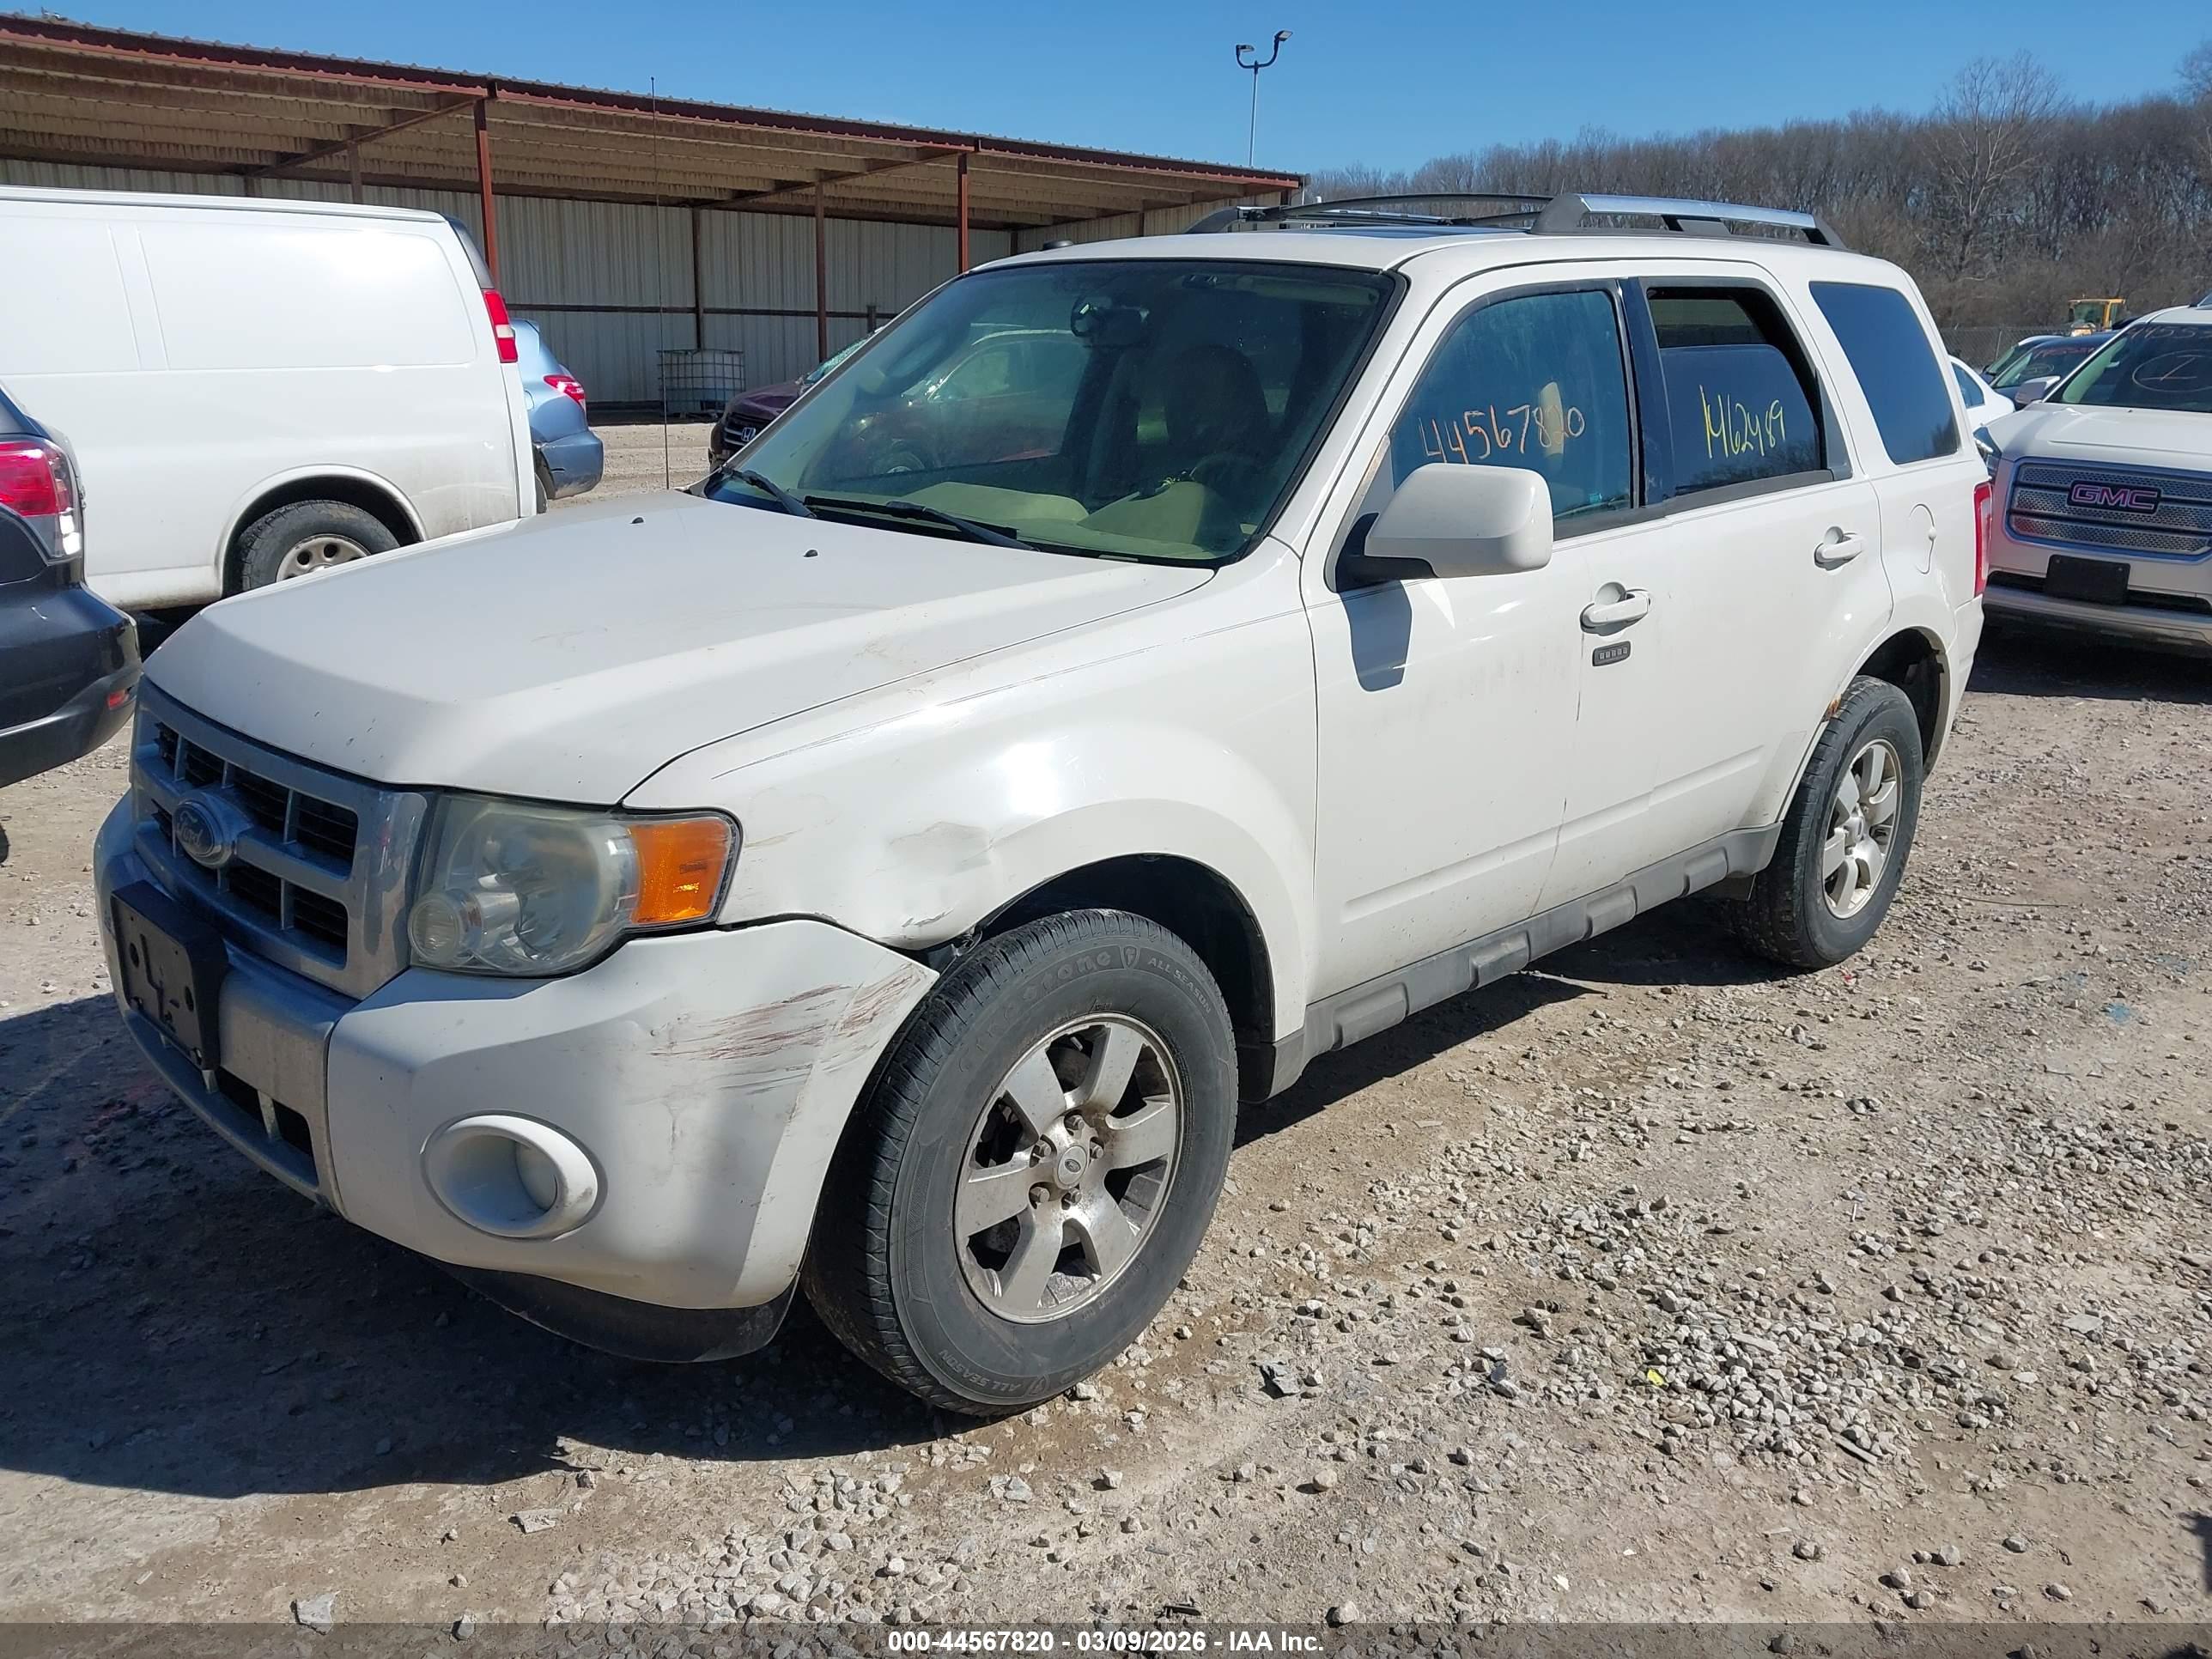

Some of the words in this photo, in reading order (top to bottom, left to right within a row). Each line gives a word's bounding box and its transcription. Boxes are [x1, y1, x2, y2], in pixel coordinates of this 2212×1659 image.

[1418, 404, 1586, 465] 44567820
[2071, 483, 2158, 510] GMC
[177, 810, 204, 847] Ford
[1147, 957, 1171, 973] ALL
[1173, 969, 1212, 1014] SEASON
[938, 1349, 990, 1388] SEASON
[993, 1381, 1022, 1393] ALL
